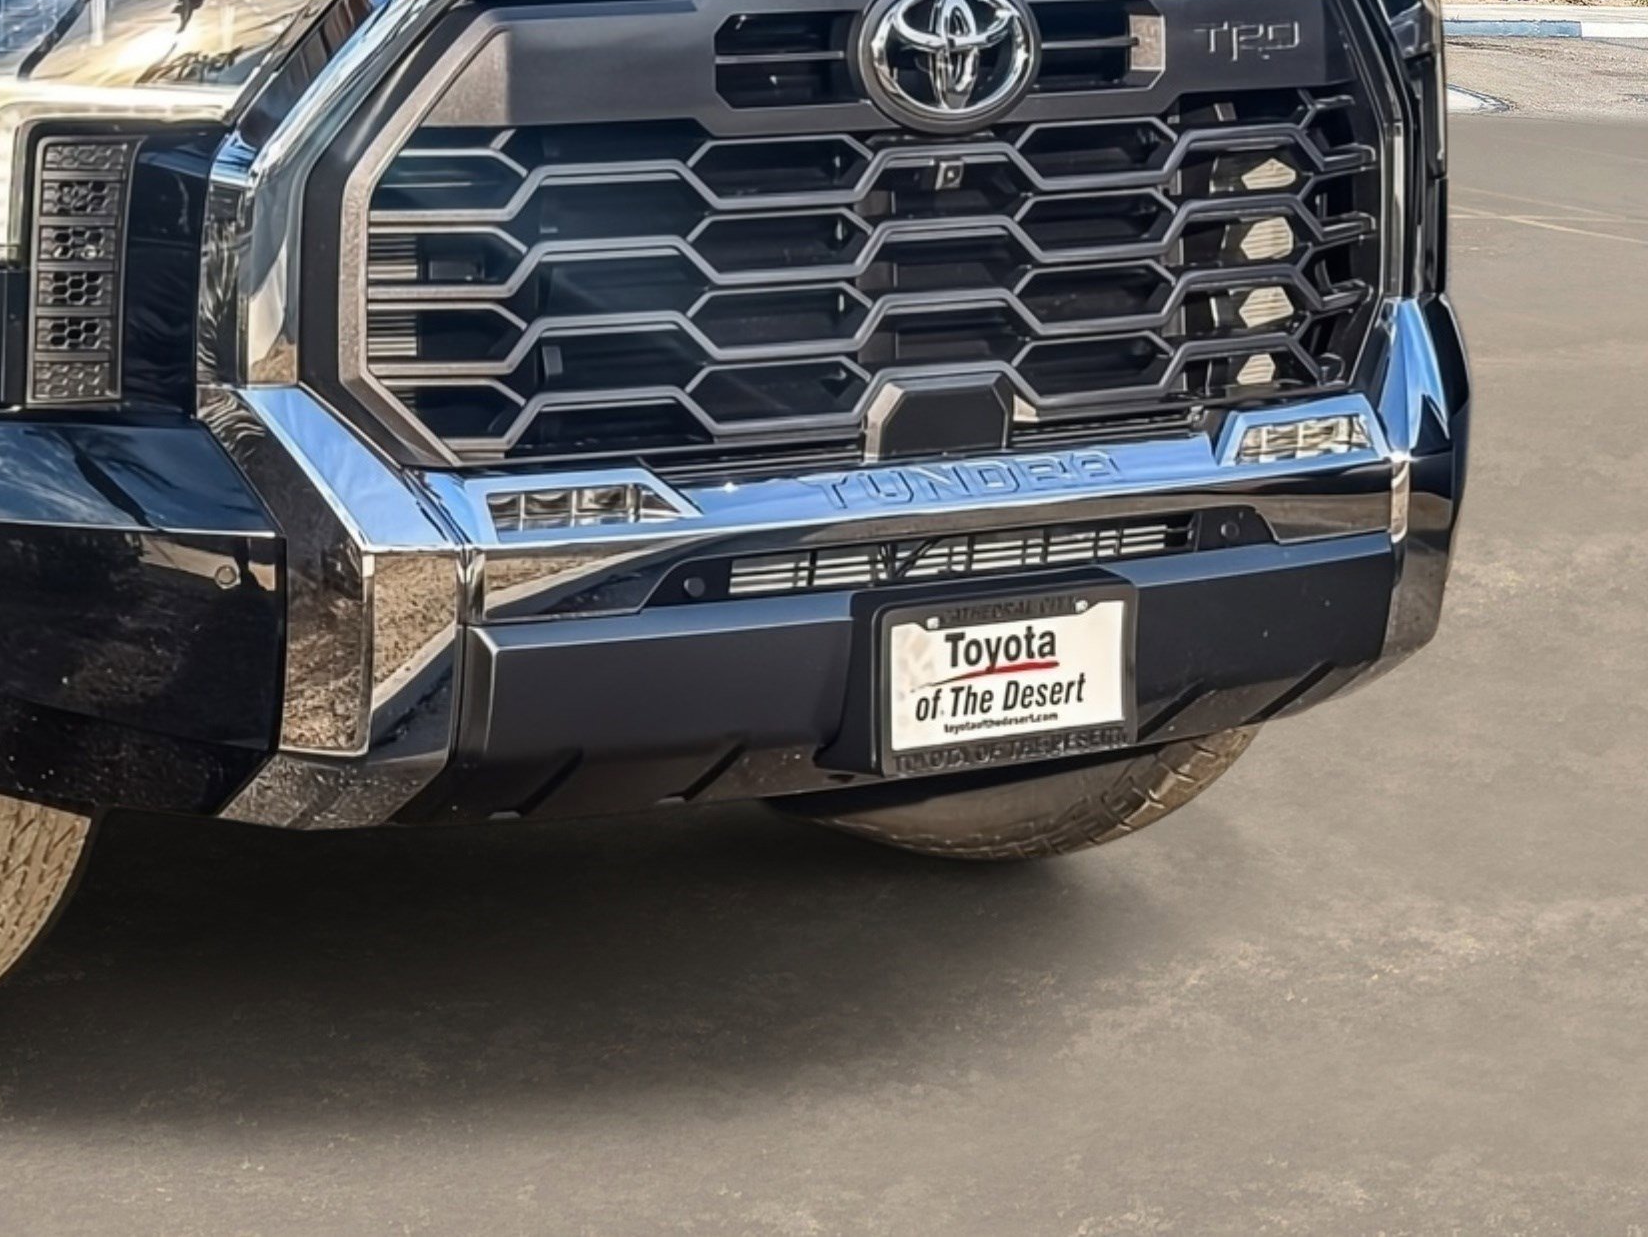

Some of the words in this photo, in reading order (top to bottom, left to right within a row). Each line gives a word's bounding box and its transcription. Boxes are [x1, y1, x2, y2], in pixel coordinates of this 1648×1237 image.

[1194, 21, 1300, 61] TRD
[944, 625, 1057, 672] Toyota
[915, 688, 942, 722] of
[950, 684, 994, 718] The
[1002, 673, 1086, 712] Desert
[944, 711, 1058, 734] toyotaofthedesert.com
